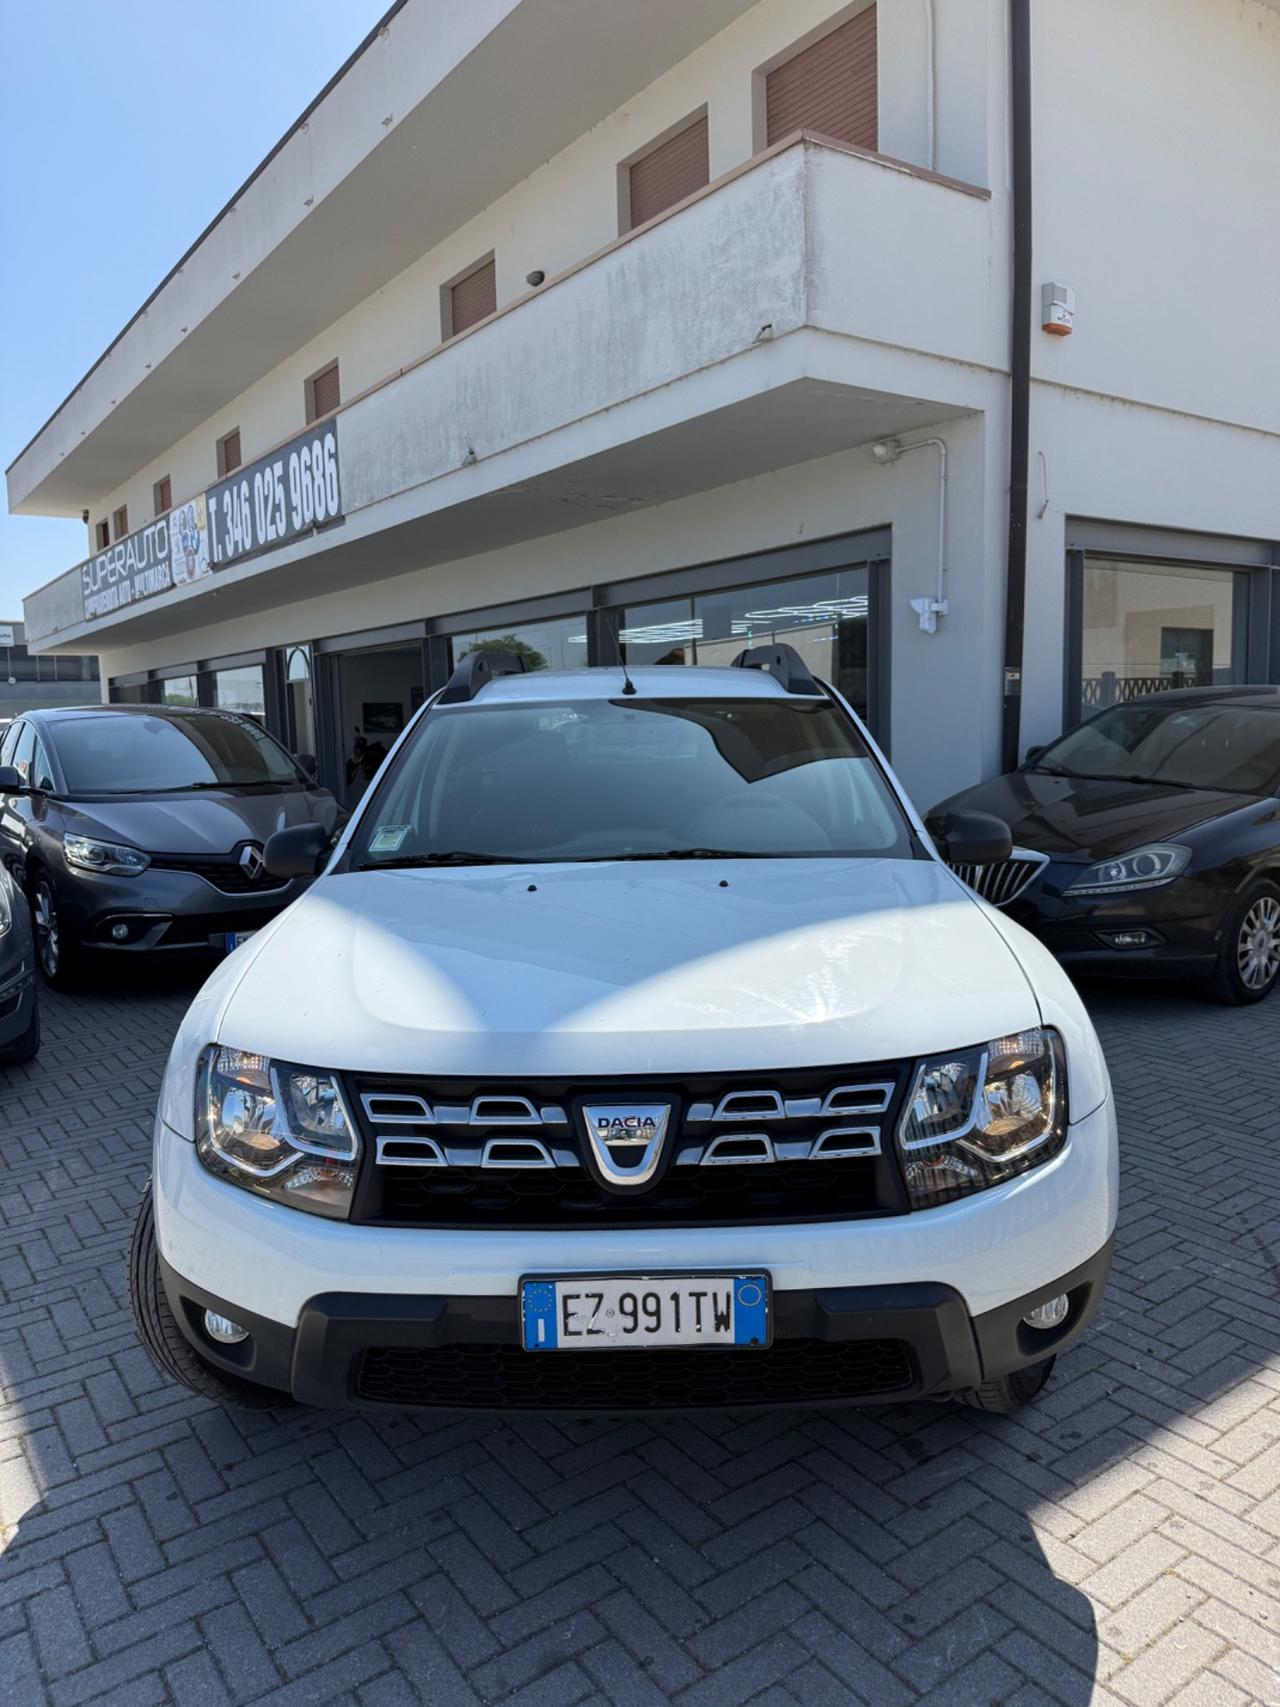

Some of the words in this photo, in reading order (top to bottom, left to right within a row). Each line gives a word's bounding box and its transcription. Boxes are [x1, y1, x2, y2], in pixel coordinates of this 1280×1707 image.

[208, 496, 222, 562] T.
[223, 480, 252, 557] 346
[254, 461, 286, 544] 025
[289, 433, 338, 530] 9686
[82, 520, 168, 595] SUPERAUTO
[598, 1116, 656, 1128] DACIA
